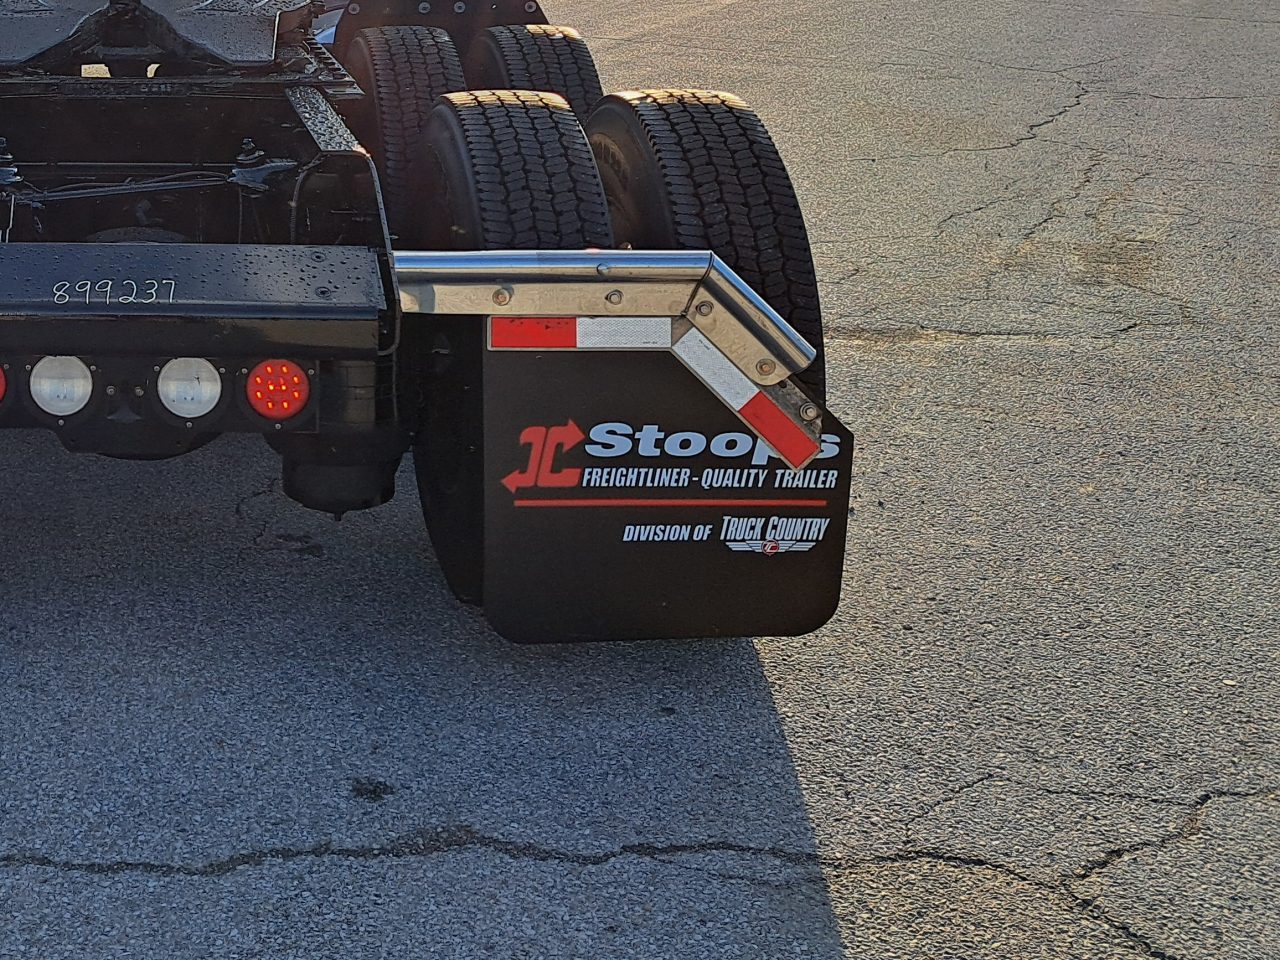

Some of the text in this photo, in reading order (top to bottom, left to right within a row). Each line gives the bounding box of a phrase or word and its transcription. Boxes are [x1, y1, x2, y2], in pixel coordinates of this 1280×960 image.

[53, 280, 175, 304] 899237
[582, 467, 689, 487] FREIGHTLINER
[701, 469, 768, 490] QUALITY
[774, 469, 838, 488] TRAILER
[623, 516, 830, 541] DIVISION OF TRUCK COUNTRY
